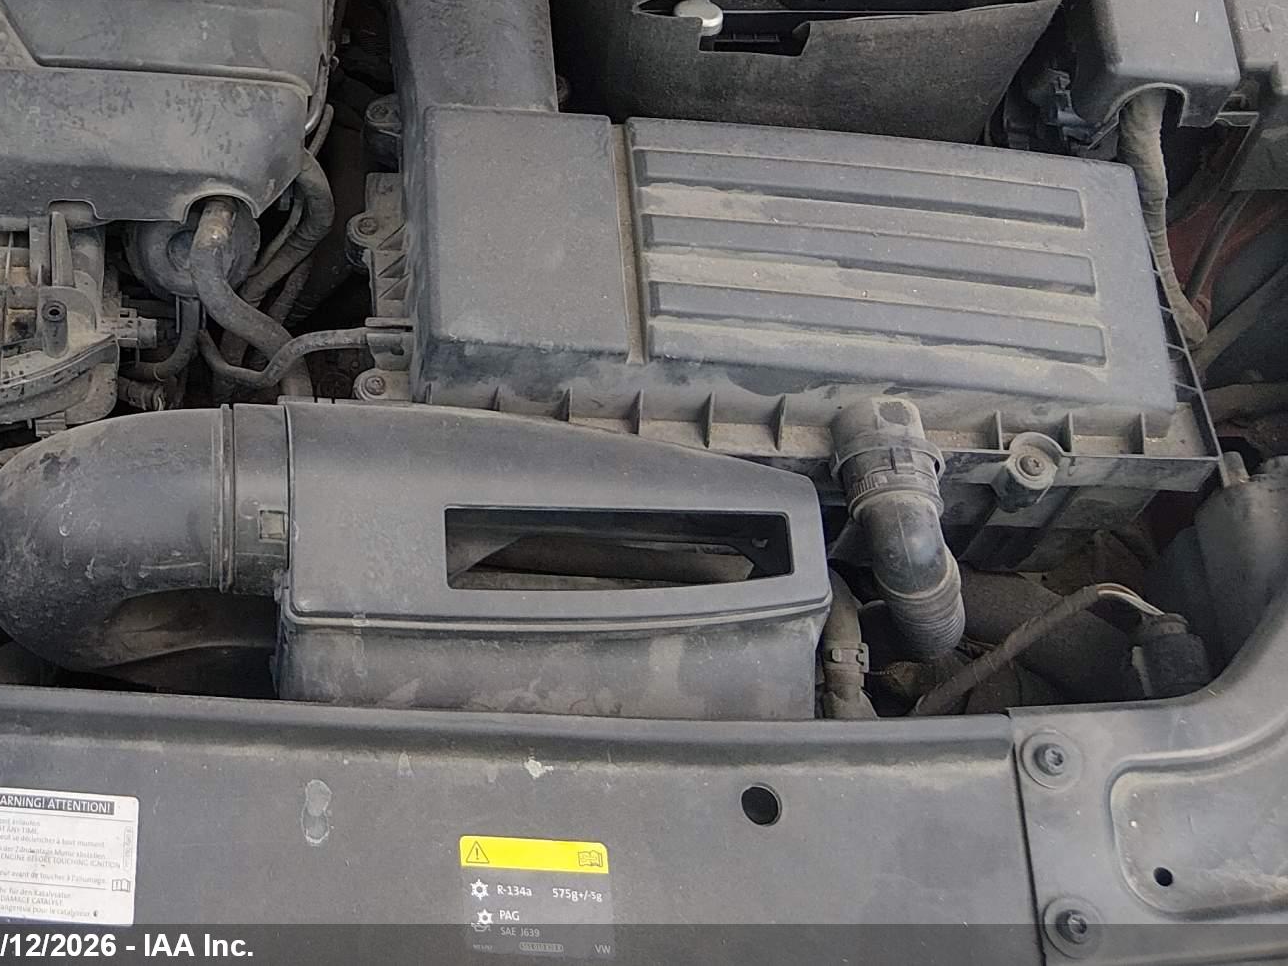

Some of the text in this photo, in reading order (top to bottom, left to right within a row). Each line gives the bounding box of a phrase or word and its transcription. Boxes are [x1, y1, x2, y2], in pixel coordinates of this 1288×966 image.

[48, 798, 109, 812] ATTENTION!
[497, 884, 532, 897] R-134a
[499, 910, 520, 921] PAG
[500, 927, 516, 936] SAE
[594, 944, 611, 954] VW
